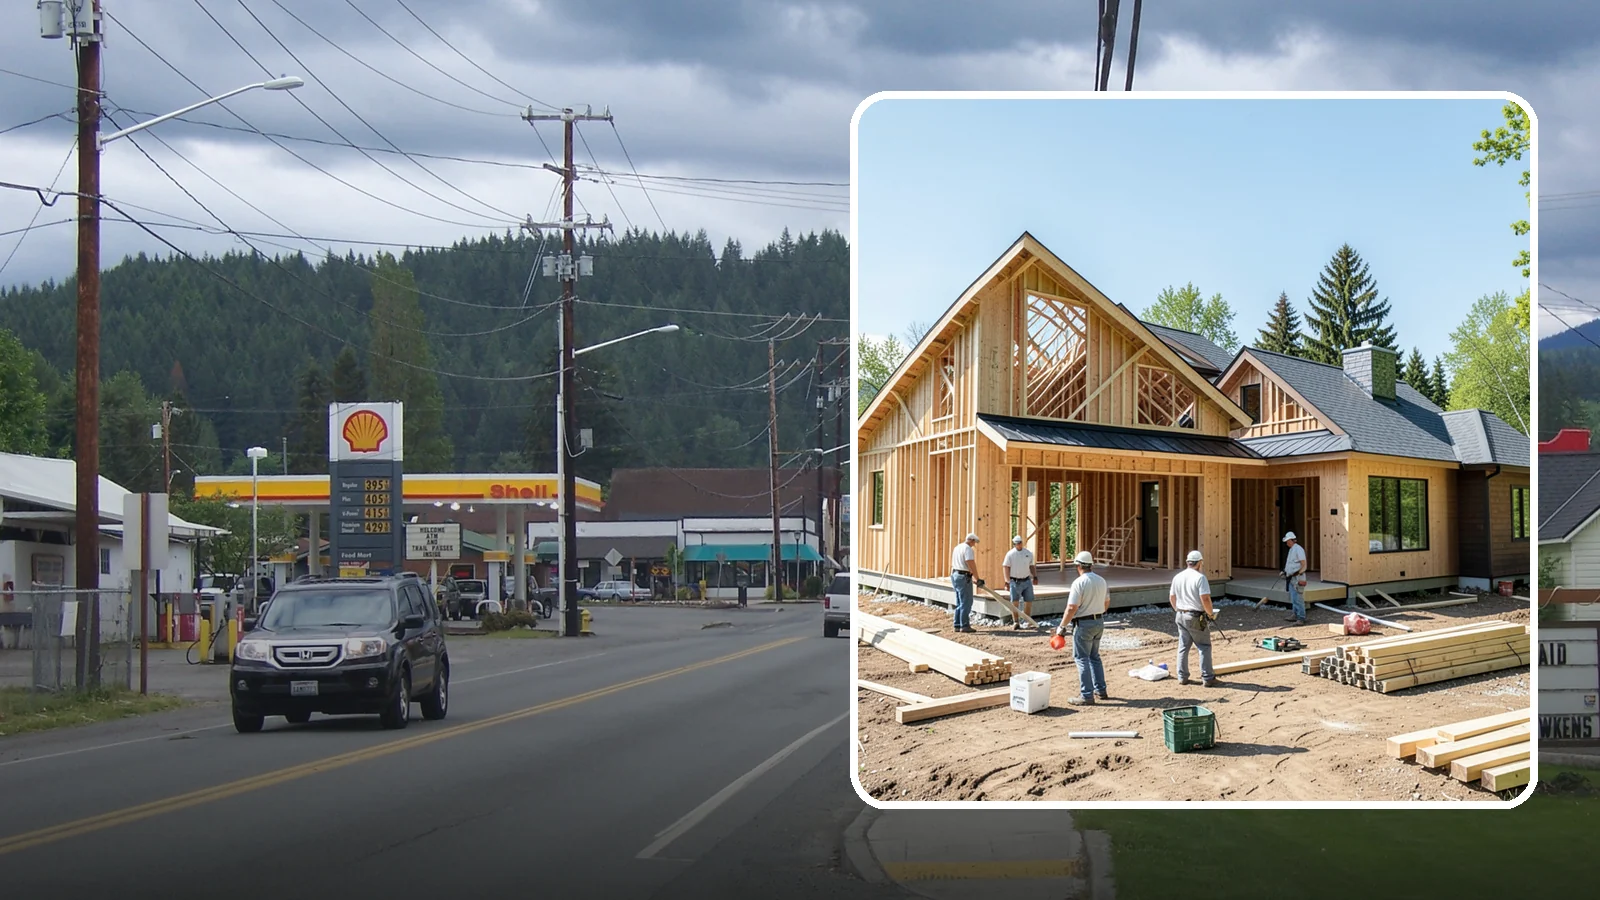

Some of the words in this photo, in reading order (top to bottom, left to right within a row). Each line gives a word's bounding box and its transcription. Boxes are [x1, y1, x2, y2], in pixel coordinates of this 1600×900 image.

[366, 480, 383, 490] 395
[490, 484, 547, 498] Shell
[366, 494, 383, 504] 405
[366, 508, 383, 518] 415
[366, 522, 383, 533] 429
[1538, 643, 1567, 665] AID
